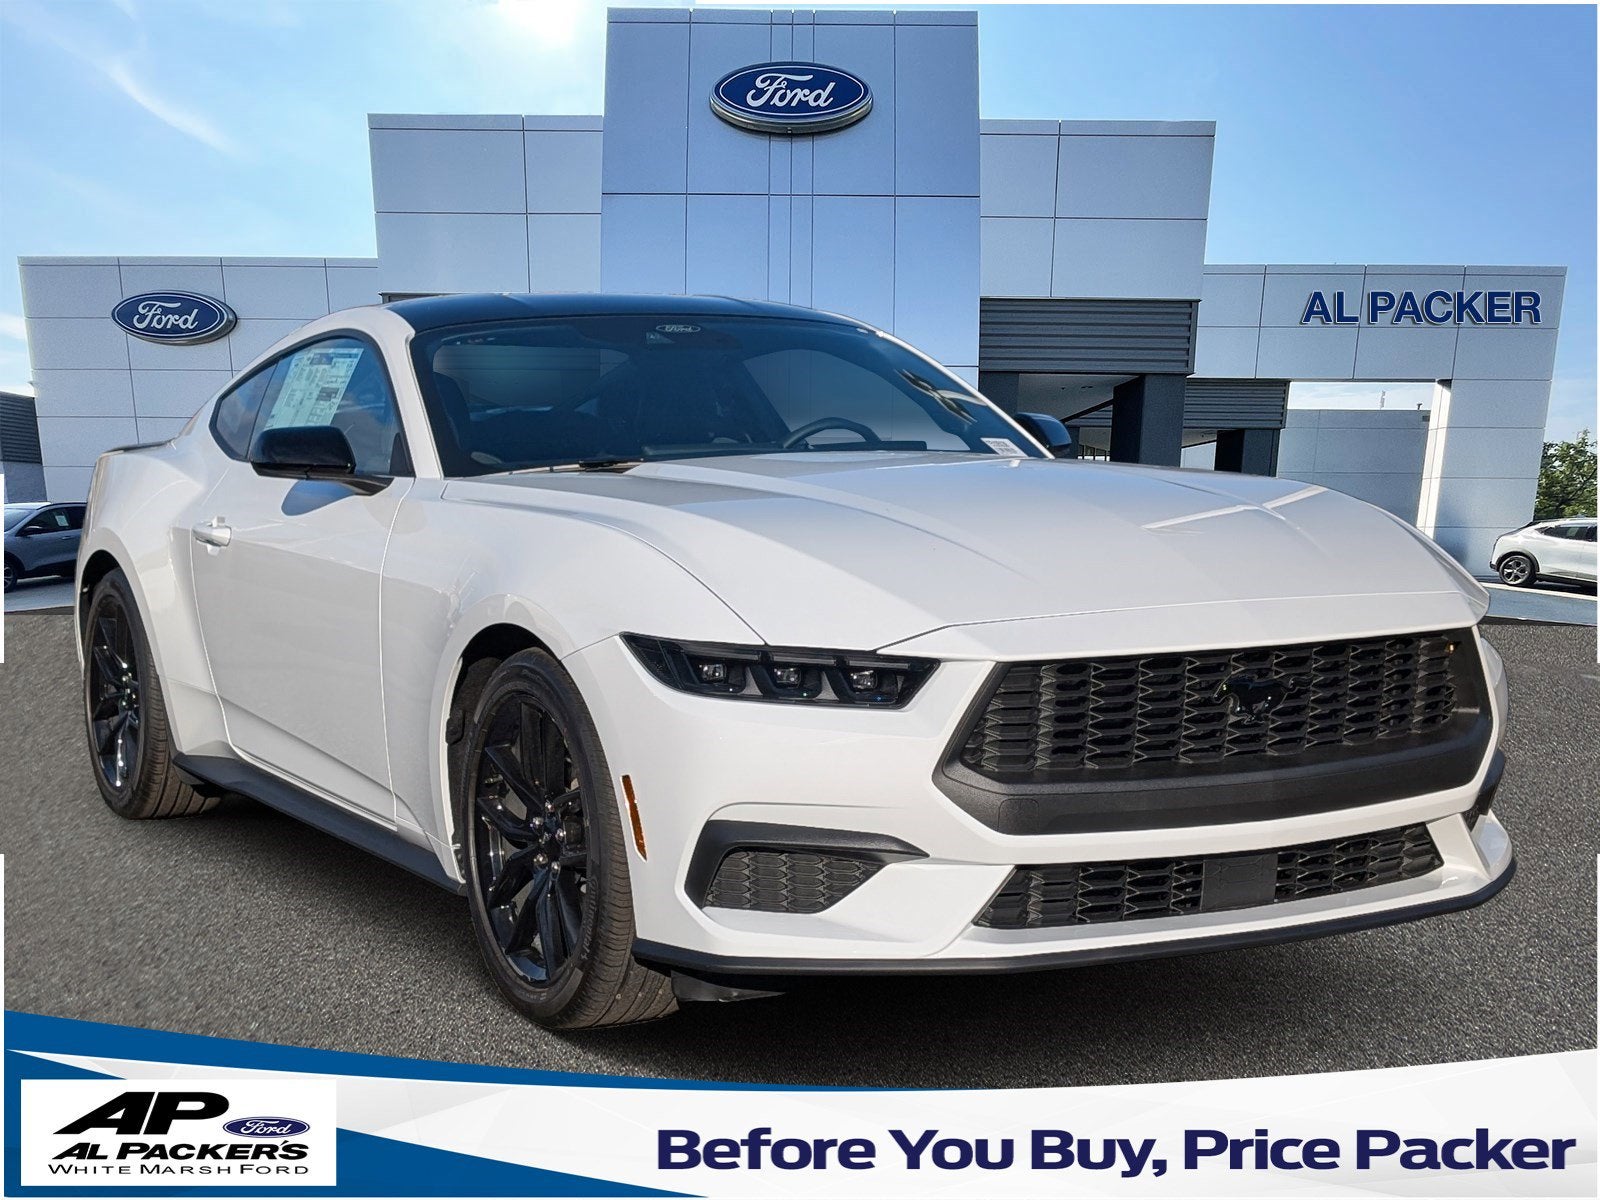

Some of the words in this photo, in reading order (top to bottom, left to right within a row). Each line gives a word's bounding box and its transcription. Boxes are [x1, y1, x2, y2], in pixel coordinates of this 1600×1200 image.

[746, 73, 836, 107] Ford
[133, 301, 198, 329] Ford
[1302, 291, 1359, 323] AL
[1369, 290, 1541, 324] PACKER
